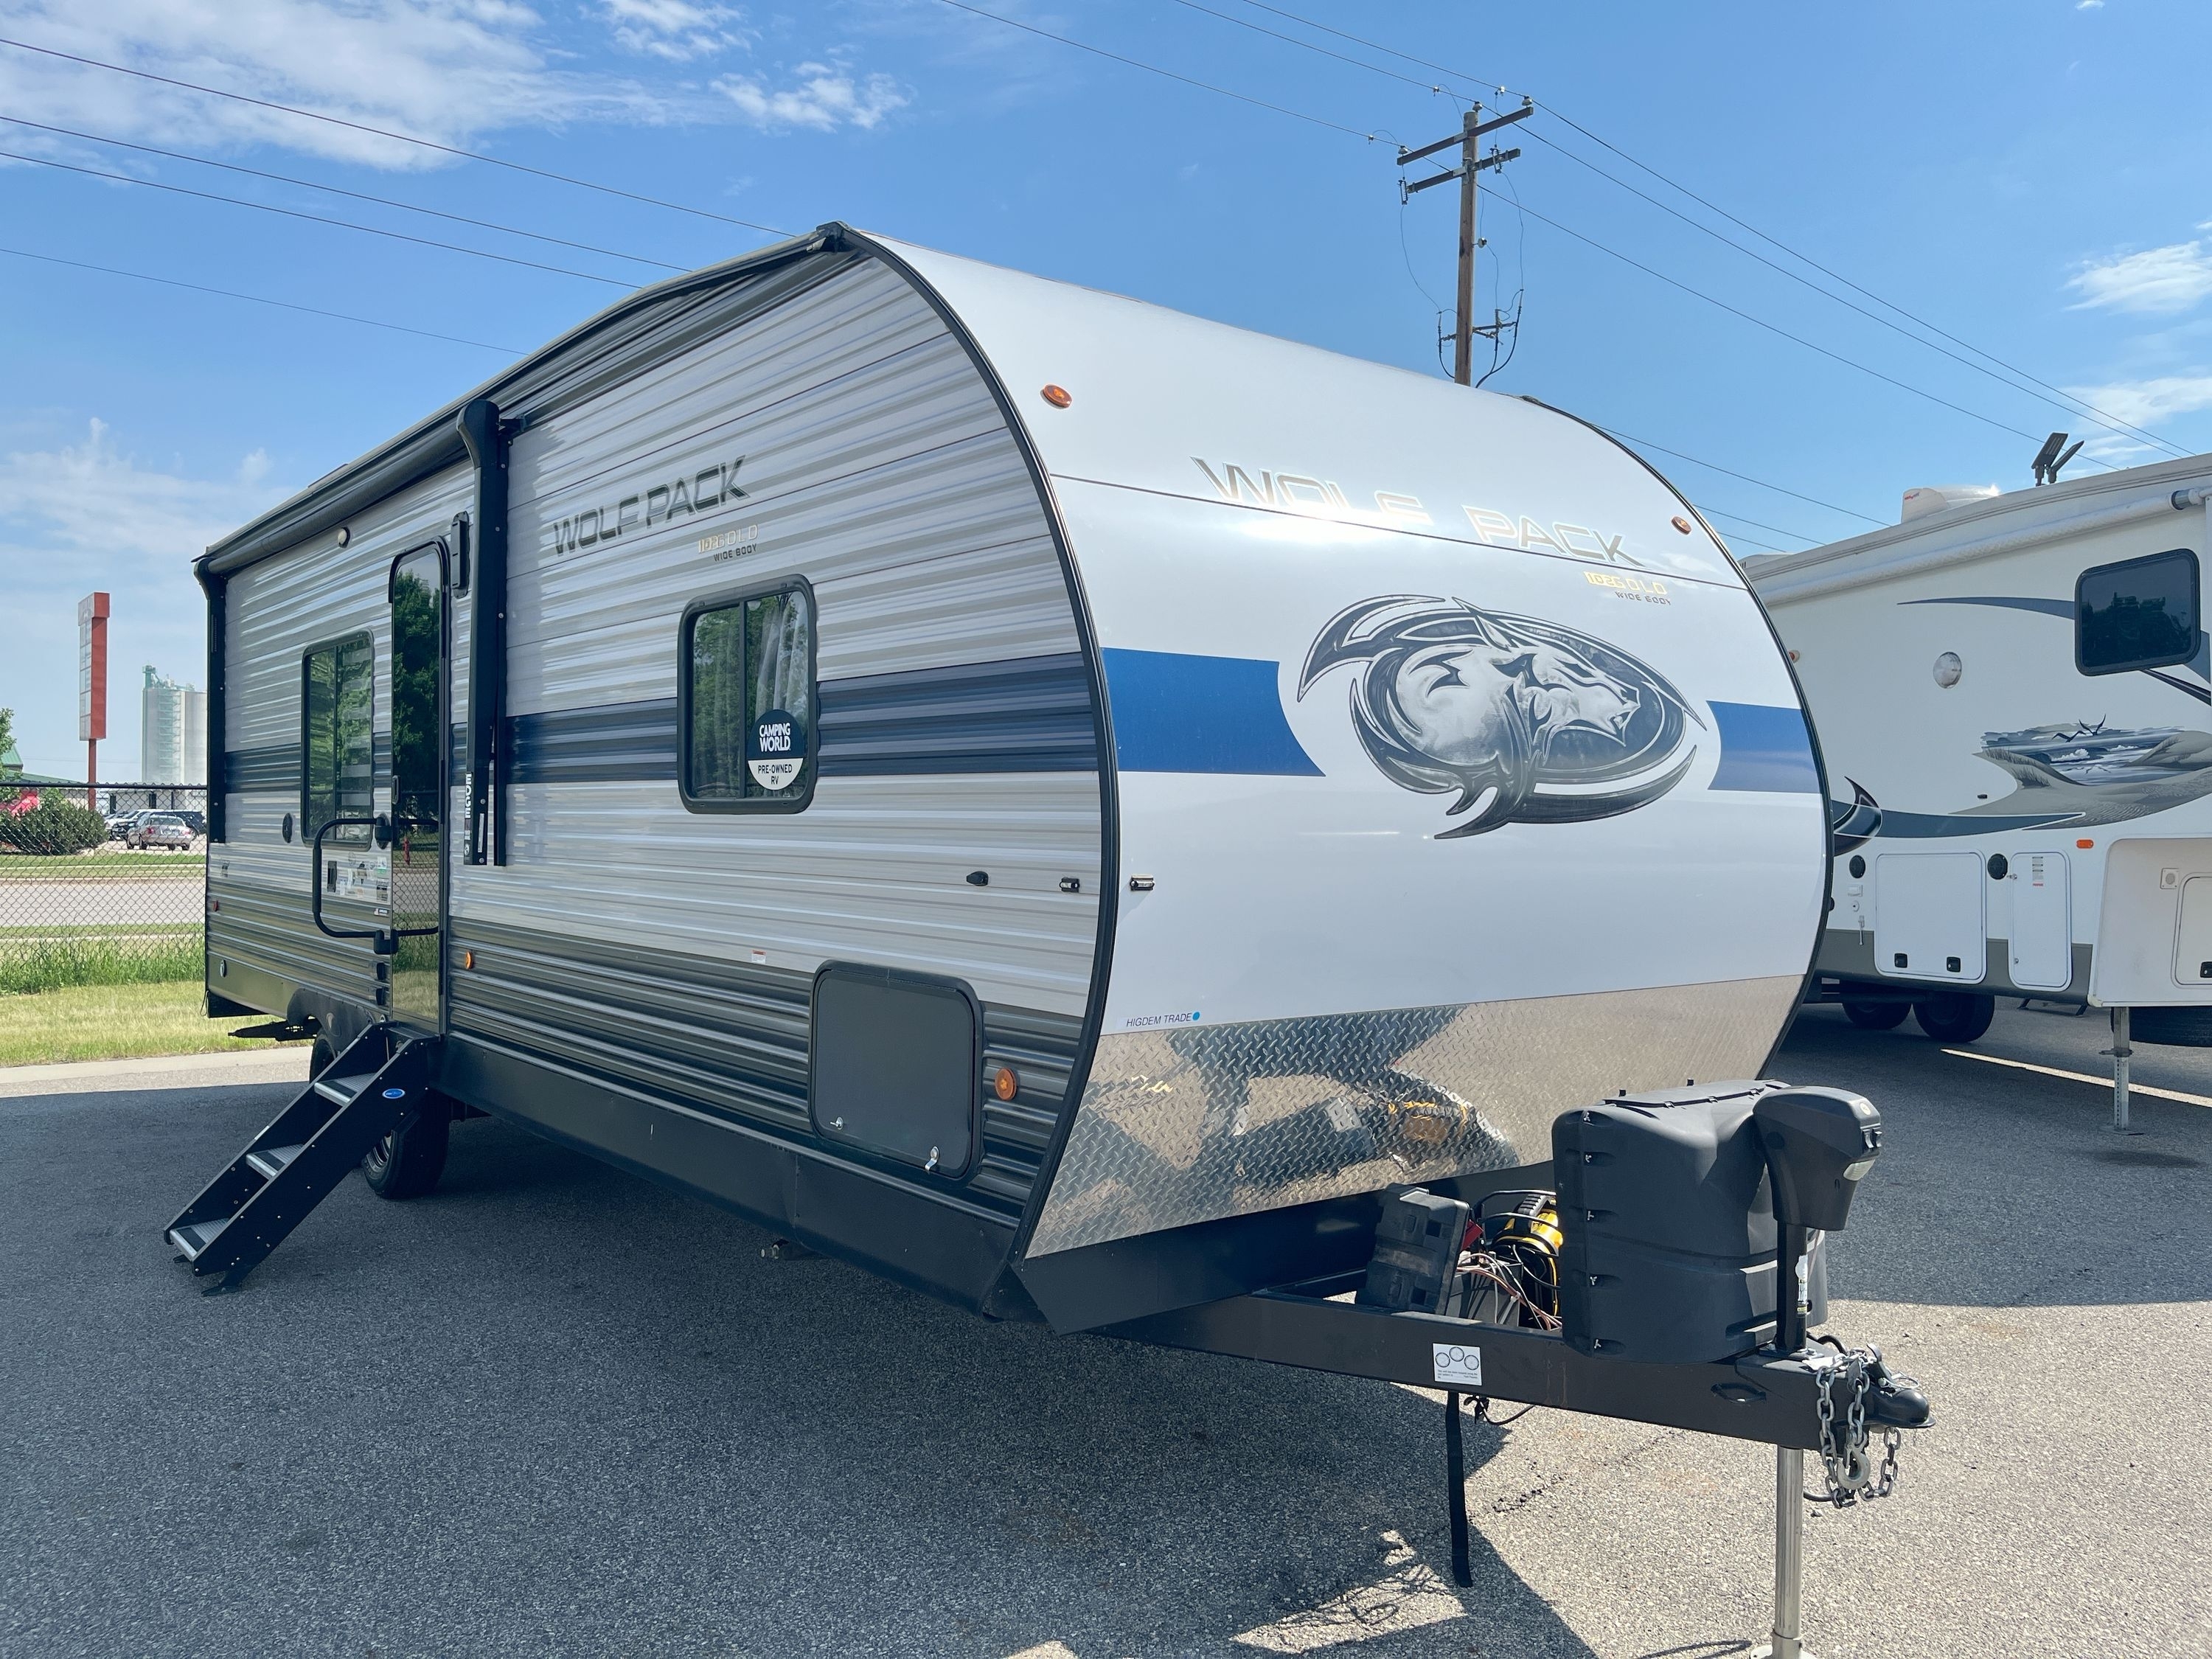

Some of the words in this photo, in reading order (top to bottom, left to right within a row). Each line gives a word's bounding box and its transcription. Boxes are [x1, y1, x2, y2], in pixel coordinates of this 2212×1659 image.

[553, 495, 639, 557] WOLF
[646, 453, 752, 529] PACK
[1461, 504, 1646, 568] PACK
[714, 549, 733, 562] WIDE
[736, 543, 757, 557] BODY
[1615, 591, 1642, 602] WIDE
[759, 722, 791, 737] CAMPING
[759, 736, 791, 752] WORLD
[758, 764, 793, 774] PRE-OWNED
[771, 776, 779, 785] RV
[465, 773, 473, 819] EDGE
[1126, 1016, 1162, 1027] HIGDEM
[1164, 1012, 1192, 1023] TRADE
